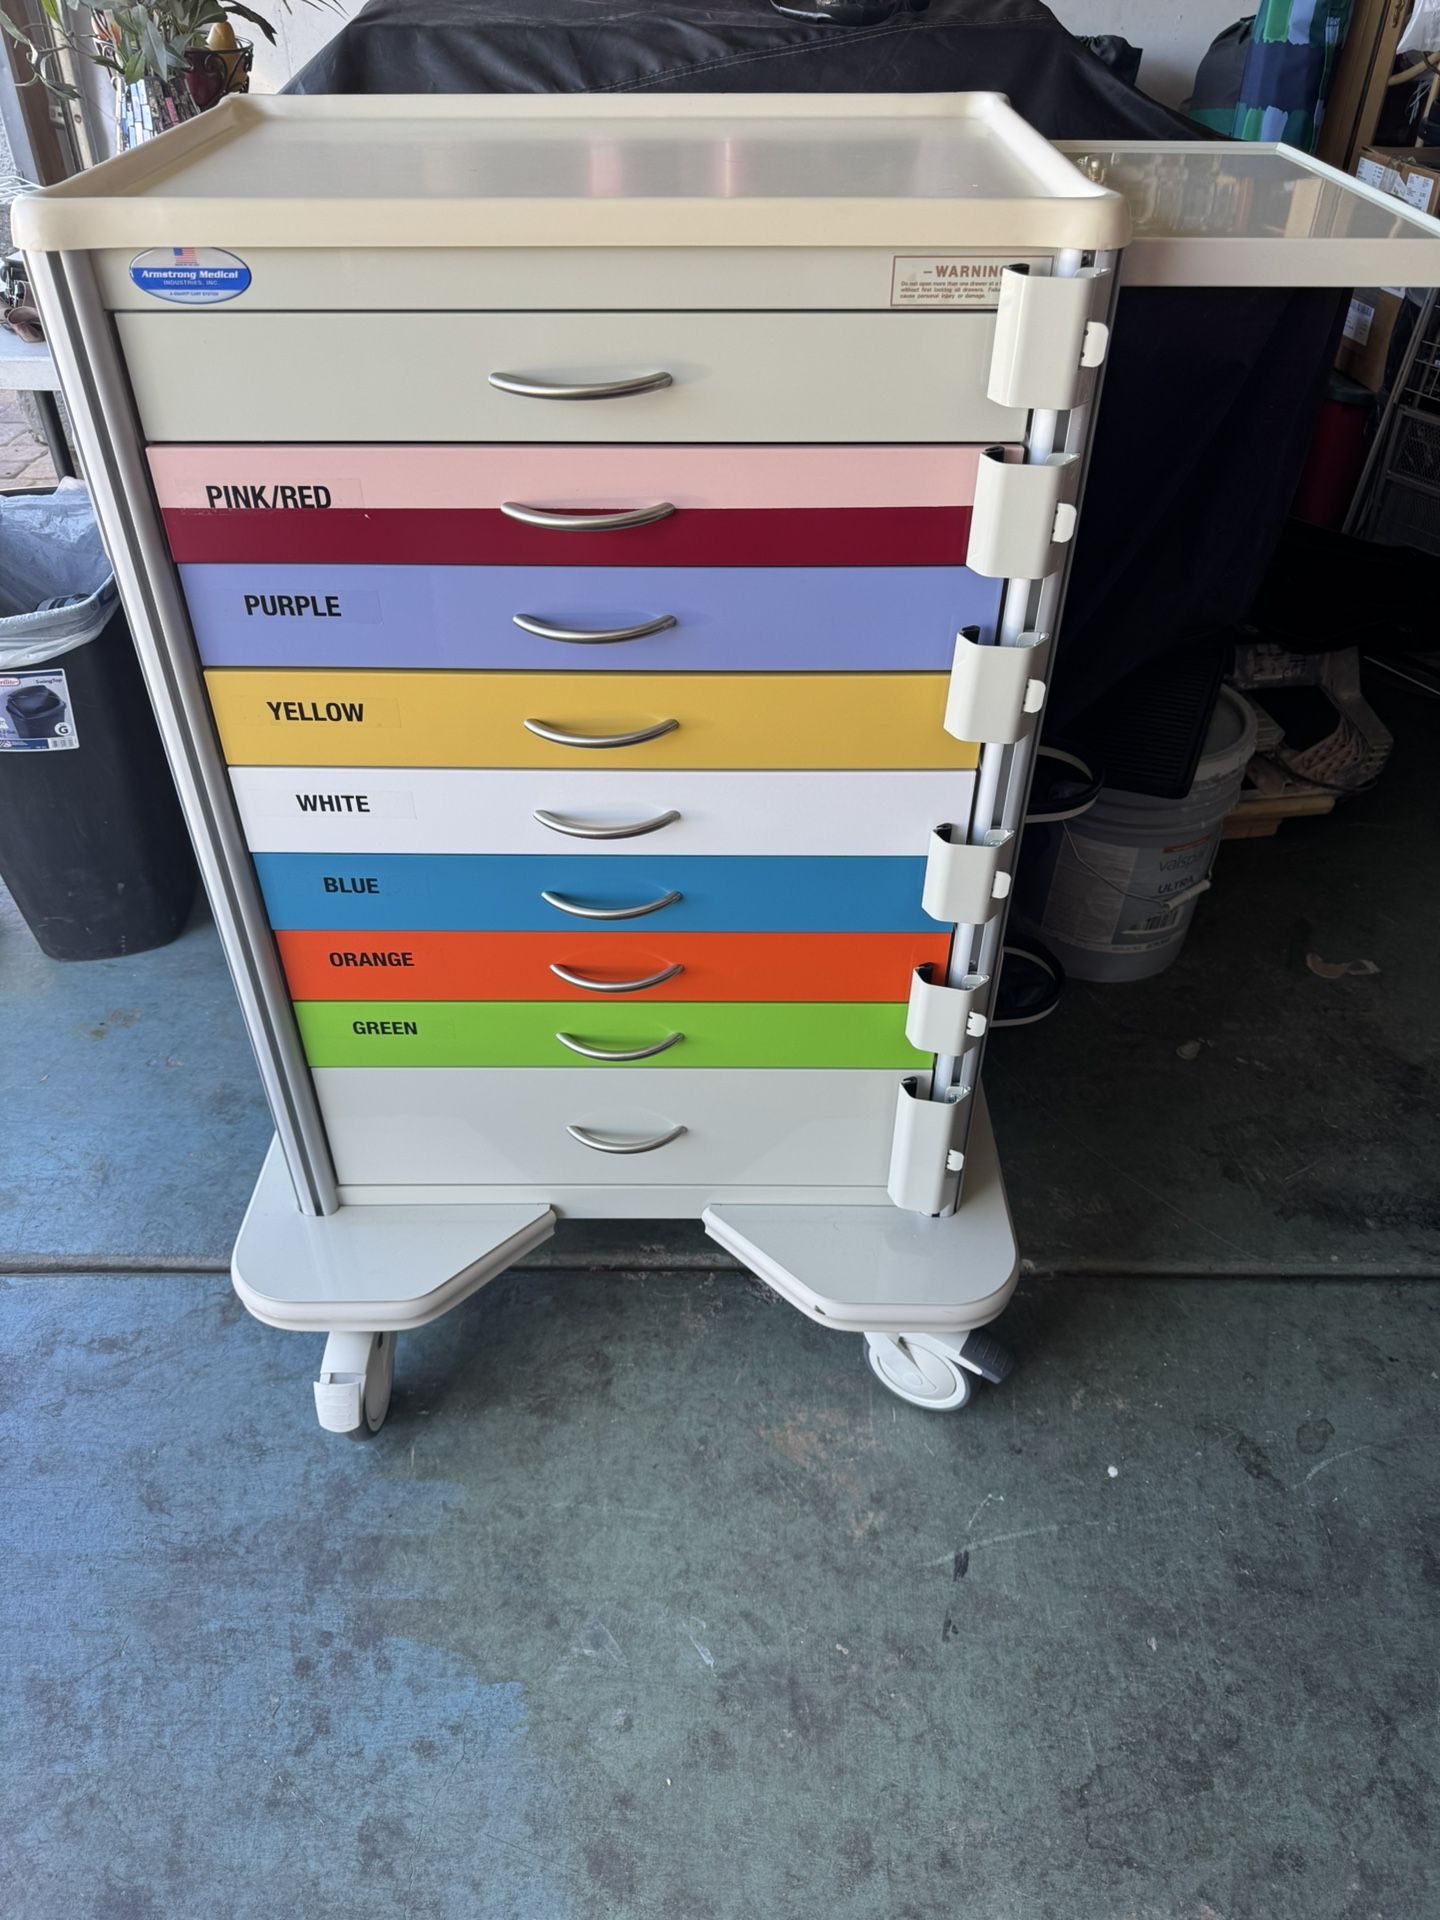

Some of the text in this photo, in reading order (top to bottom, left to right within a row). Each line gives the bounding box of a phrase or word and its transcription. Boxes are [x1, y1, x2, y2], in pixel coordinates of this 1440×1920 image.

[141, 270, 239, 280] Armstrong Medical
[205, 485, 331, 509] PINK/RED
[244, 595, 342, 617] PURPLE
[266, 701, 364, 722] YELLOW
[295, 794, 371, 812] WHITE
[323, 876, 380, 894] BLUE
[329, 952, 415, 967] ORANGE
[352, 1021, 418, 1035] GREEN
